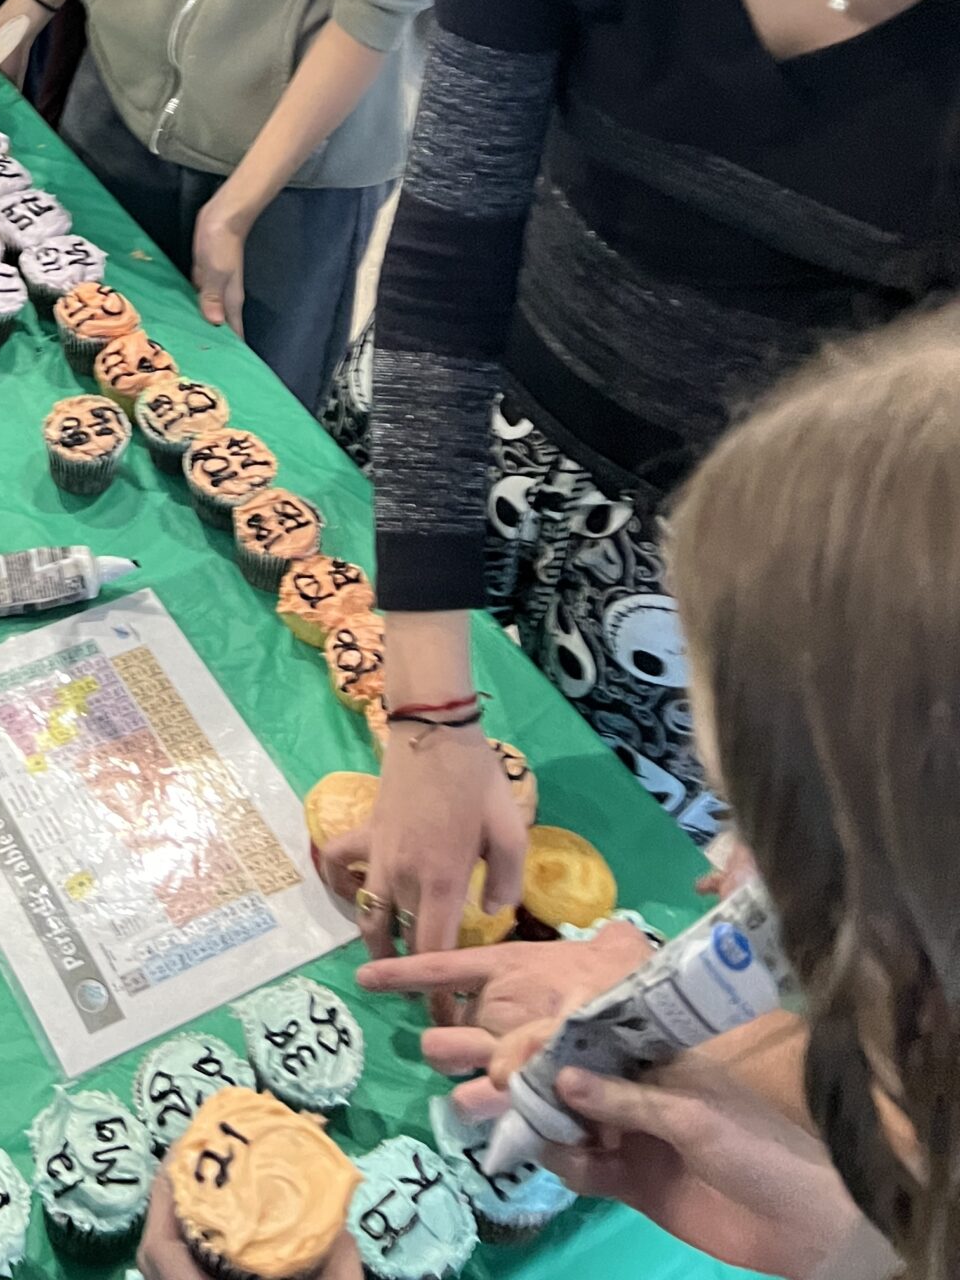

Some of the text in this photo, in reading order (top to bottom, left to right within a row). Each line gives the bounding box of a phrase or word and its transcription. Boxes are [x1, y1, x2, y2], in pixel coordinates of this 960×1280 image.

[28, 885, 85, 973] Periodic
[263, 1019, 319, 1078] 38
[46, 1137, 87, 1199] 12
[92, 1116, 140, 1187] Mg
[193, 1121, 251, 1189] 21
[398, 1152, 445, 1204] K
[359, 1189, 421, 1256] 19
